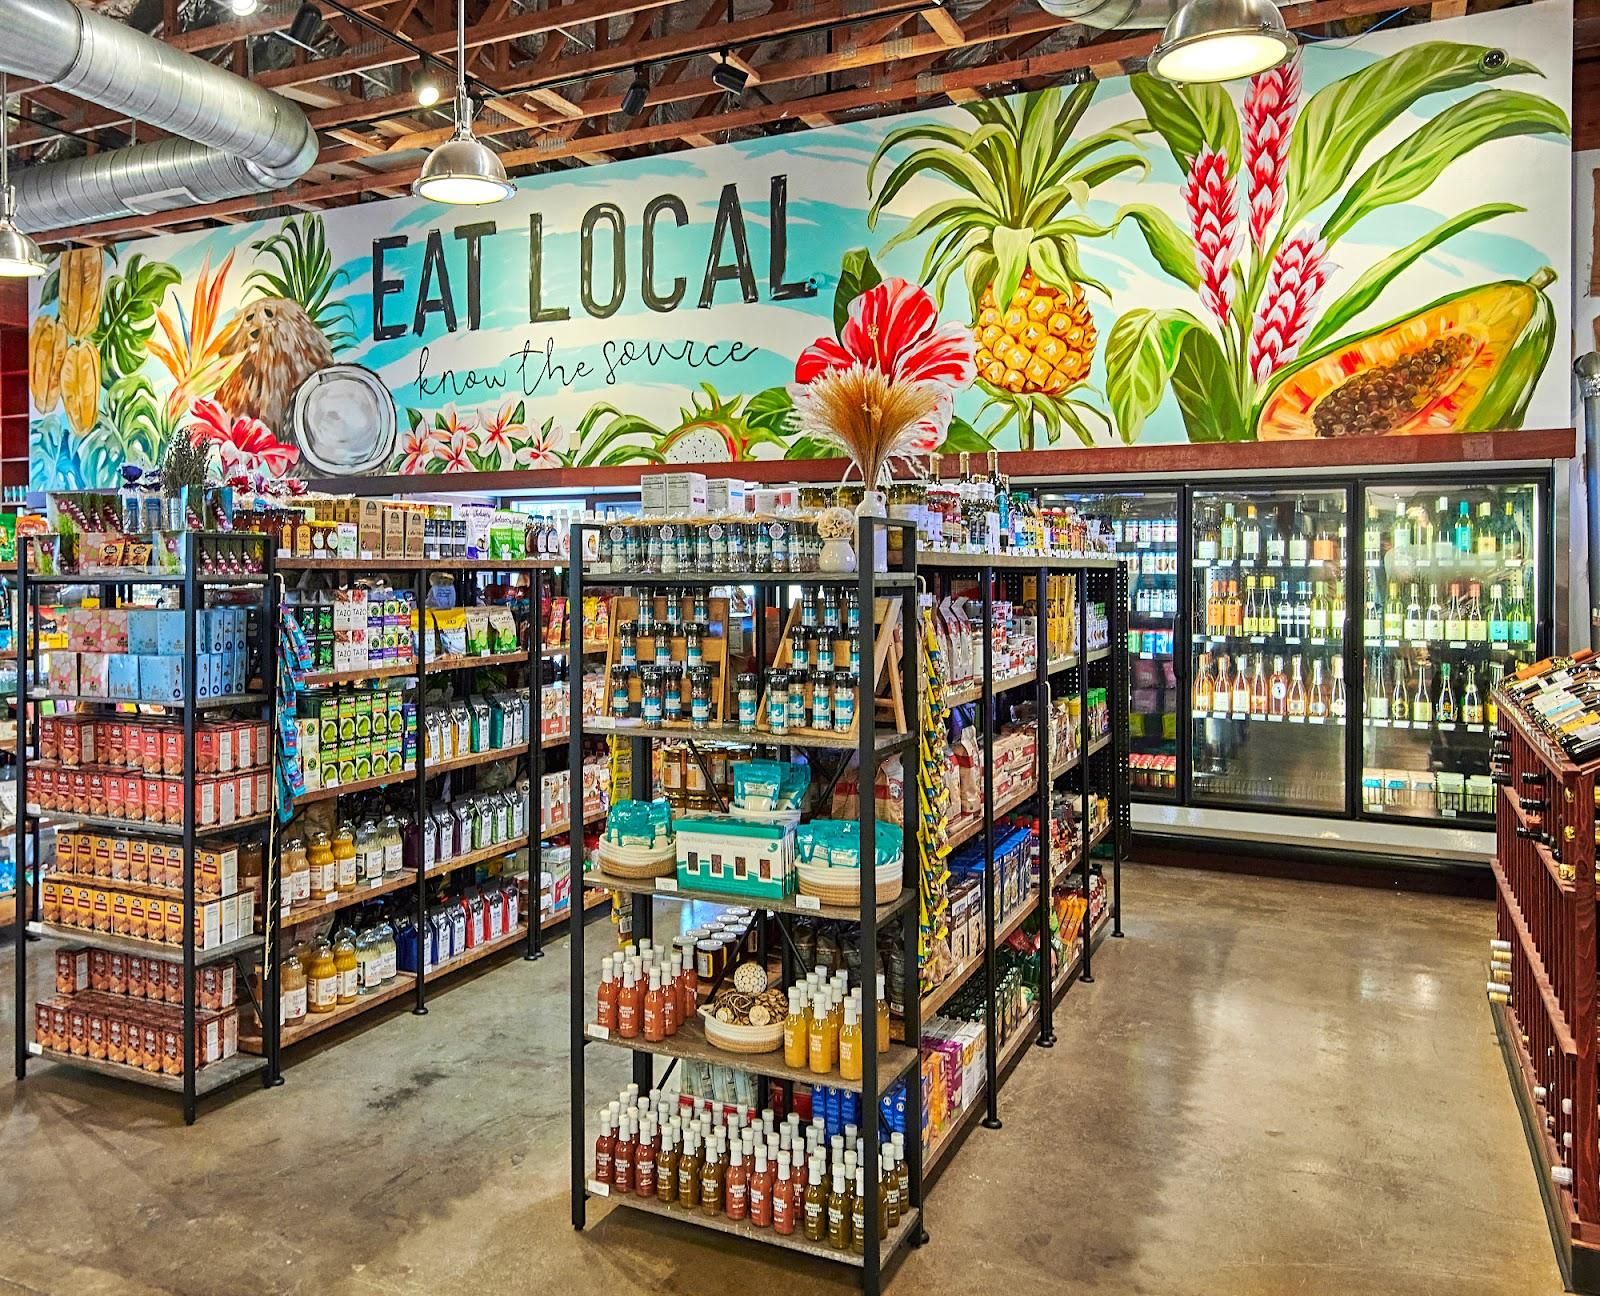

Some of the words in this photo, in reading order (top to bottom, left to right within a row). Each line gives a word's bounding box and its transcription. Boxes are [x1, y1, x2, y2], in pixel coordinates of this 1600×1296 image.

[372, 221, 496, 341] EAT
[529, 174, 817, 323] LOCAL
[413, 346, 508, 401] know
[509, 337, 594, 396] the
[602, 336, 759, 386] source
[336, 609, 351, 617] TAZO
[353, 608, 367, 616] TAZO
[337, 650, 351, 658] TAZO
[353, 648, 367, 656] TAZO
